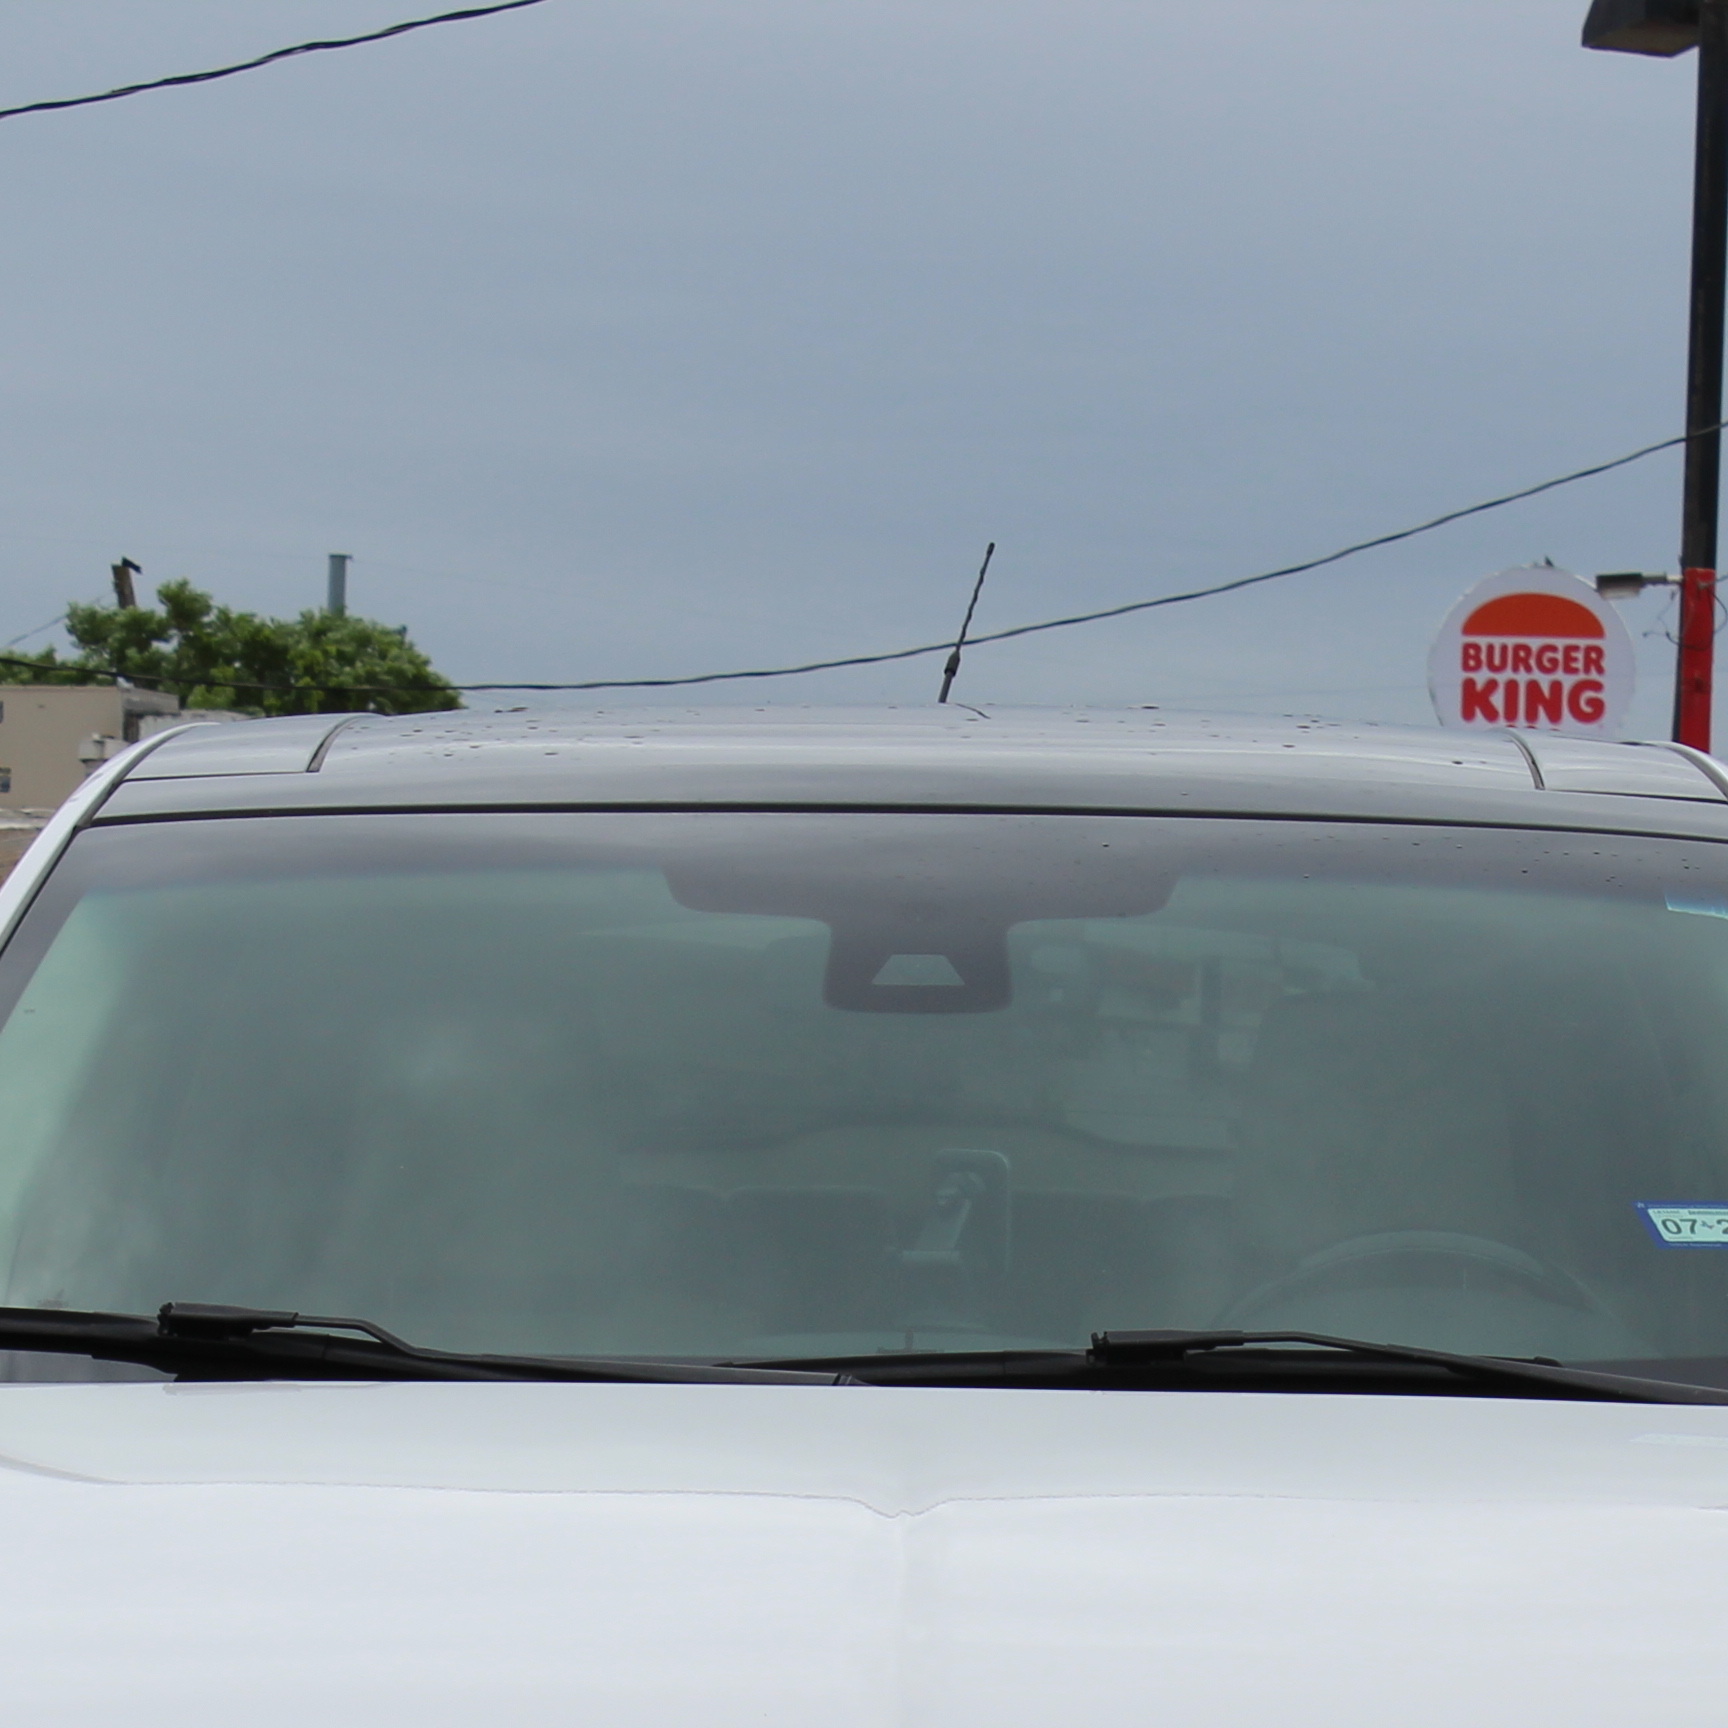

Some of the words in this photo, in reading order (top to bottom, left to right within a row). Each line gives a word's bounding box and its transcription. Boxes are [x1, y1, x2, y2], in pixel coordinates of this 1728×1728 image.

[1461, 641, 1606, 675] BURGER
[1461, 678, 1606, 725] KING
[1661, 1218, 1698, 1235] 07
